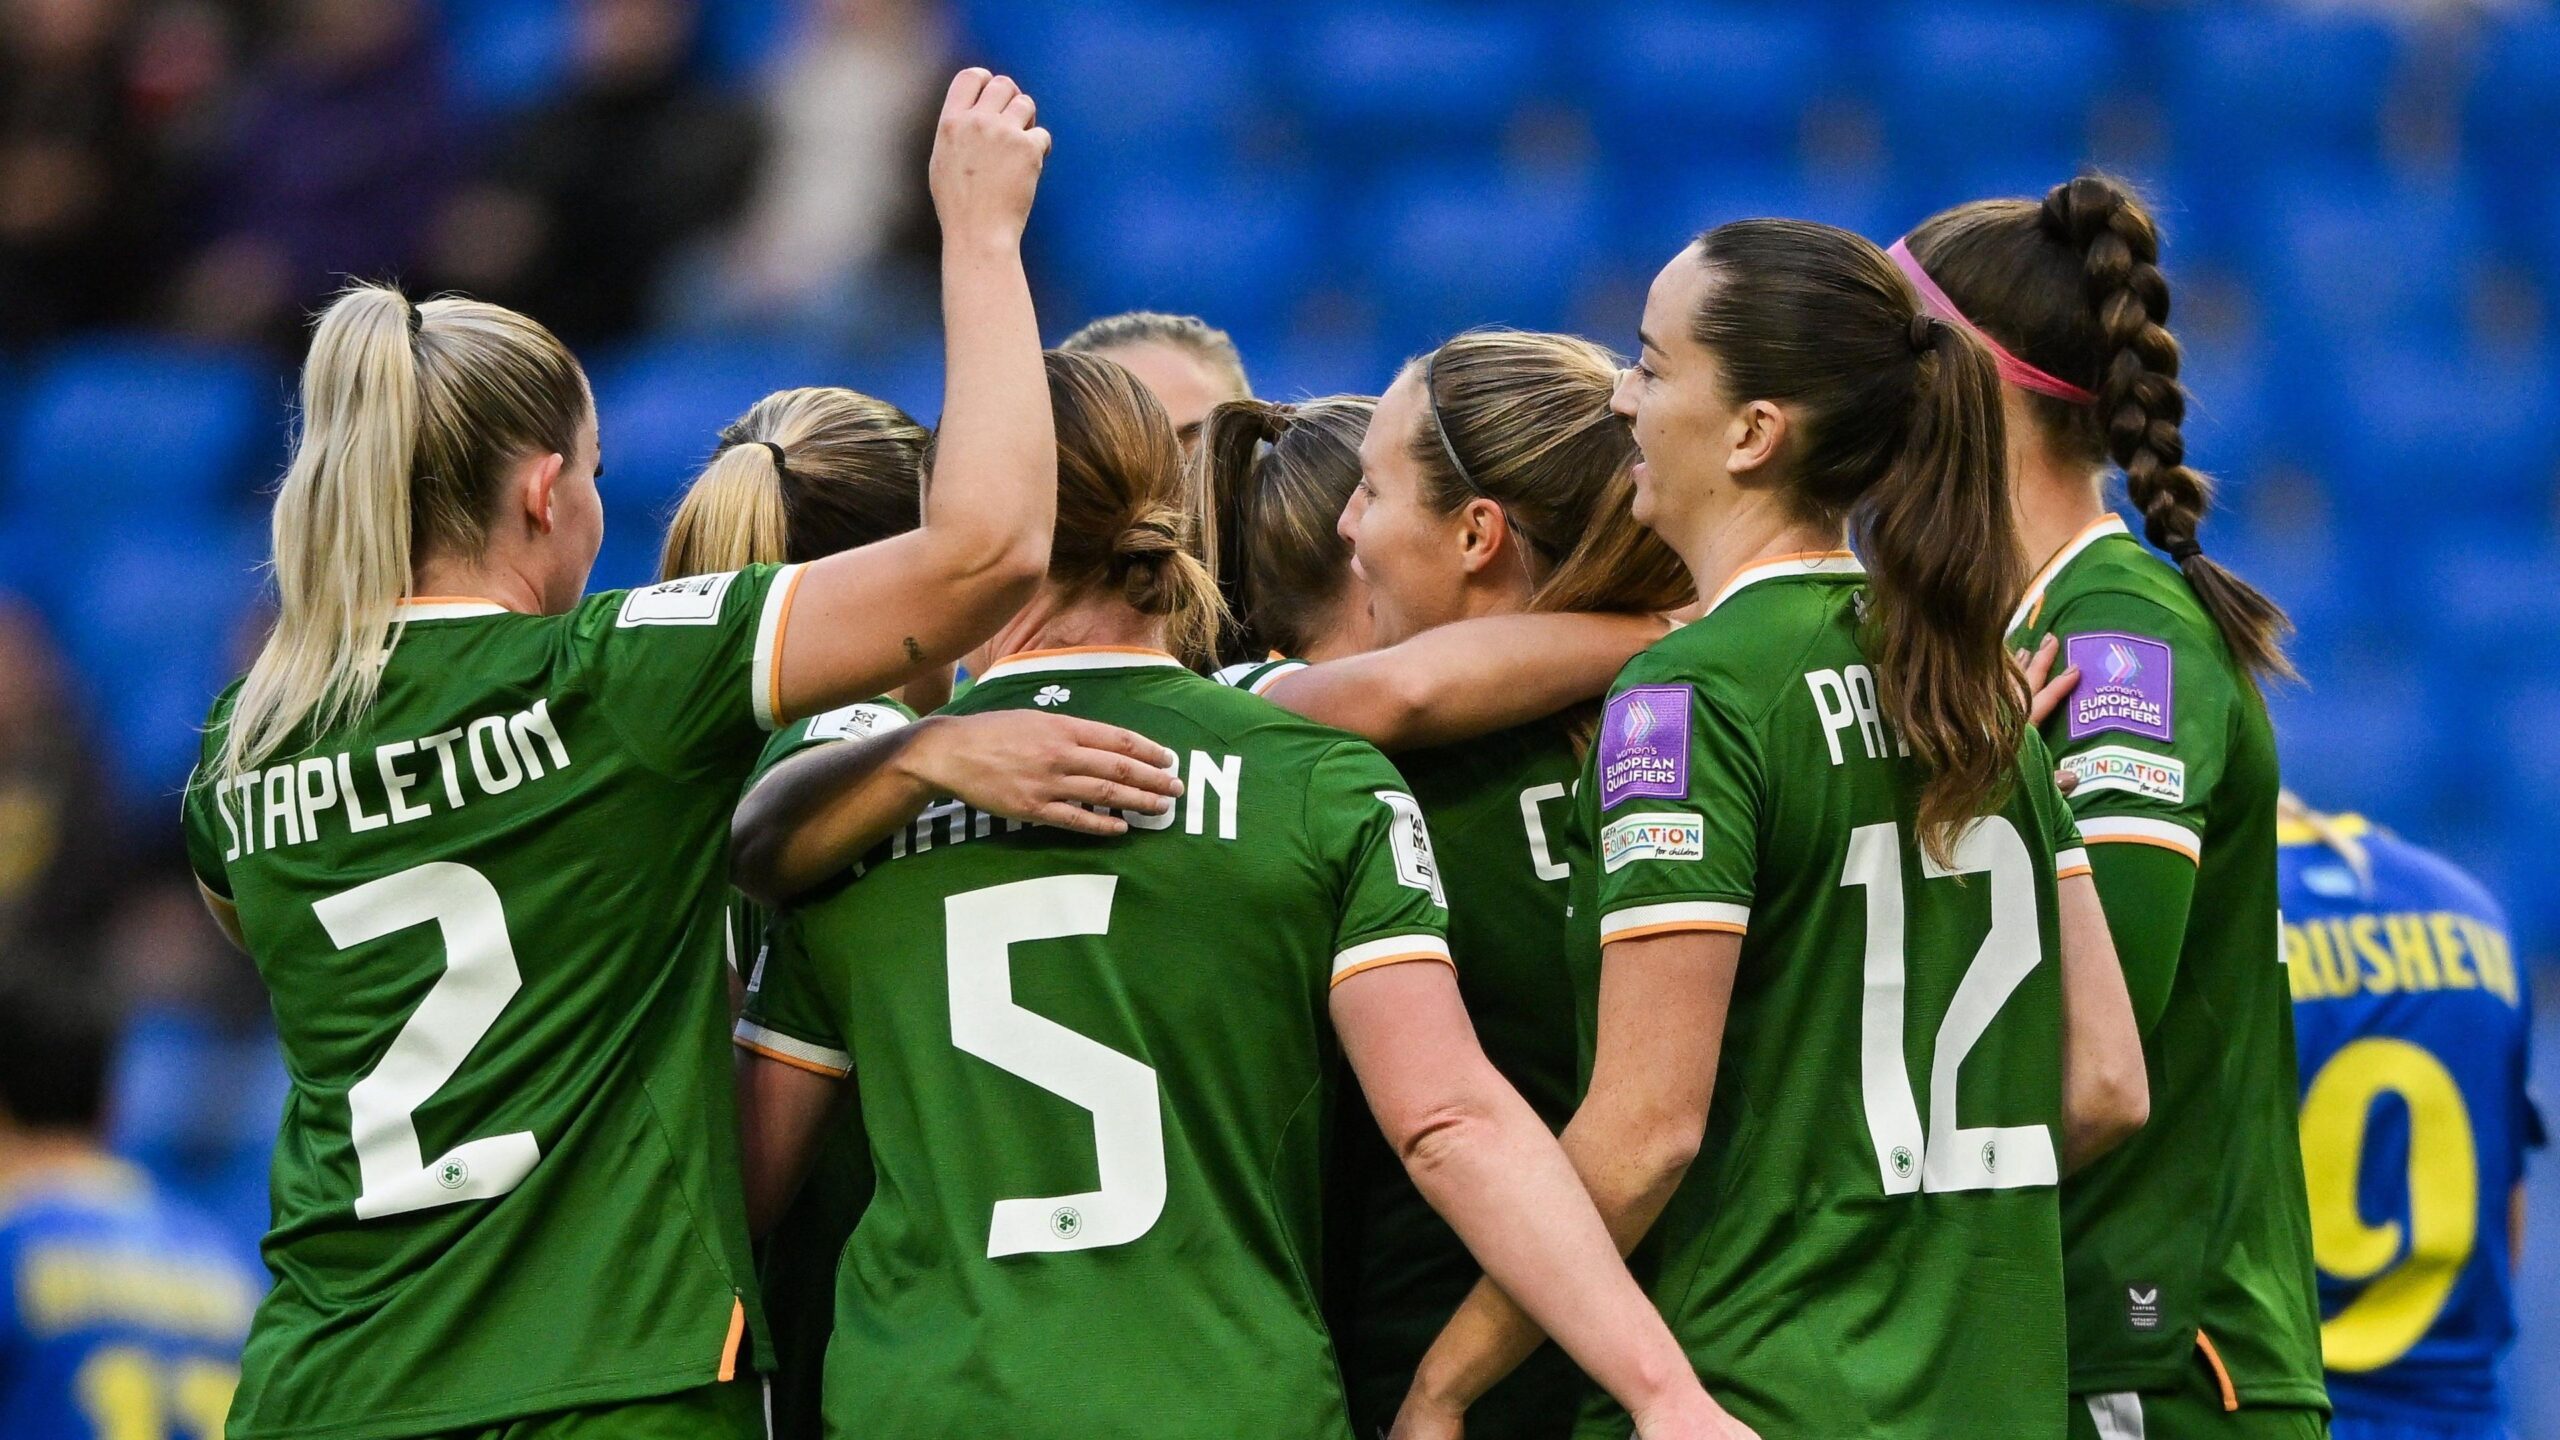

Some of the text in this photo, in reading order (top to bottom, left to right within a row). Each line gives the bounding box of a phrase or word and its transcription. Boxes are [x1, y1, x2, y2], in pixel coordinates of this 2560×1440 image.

[2095, 686, 2144, 699] women's
[2079, 694, 2160, 714] EUROPEAN
[2078, 707, 2161, 726] QUALIFIERS
[1616, 745, 1658, 760] women's
[2063, 756, 2087, 769] UEFA
[1607, 757, 1675, 778] EUROPEAN
[2077, 759, 2181, 787] OUNDATION
[215, 698, 571, 862] STAPLETON
[1607, 770, 1676, 792] QUALIFIERS
[1605, 828, 1699, 857] FOUNDATION
[1655, 847, 1699, 858] for children
[1839, 814, 2058, 1196] 12
[311, 860, 541, 1220] 2
[944, 874, 1167, 1259] 5
[2299, 1037, 2478, 1372] 9
